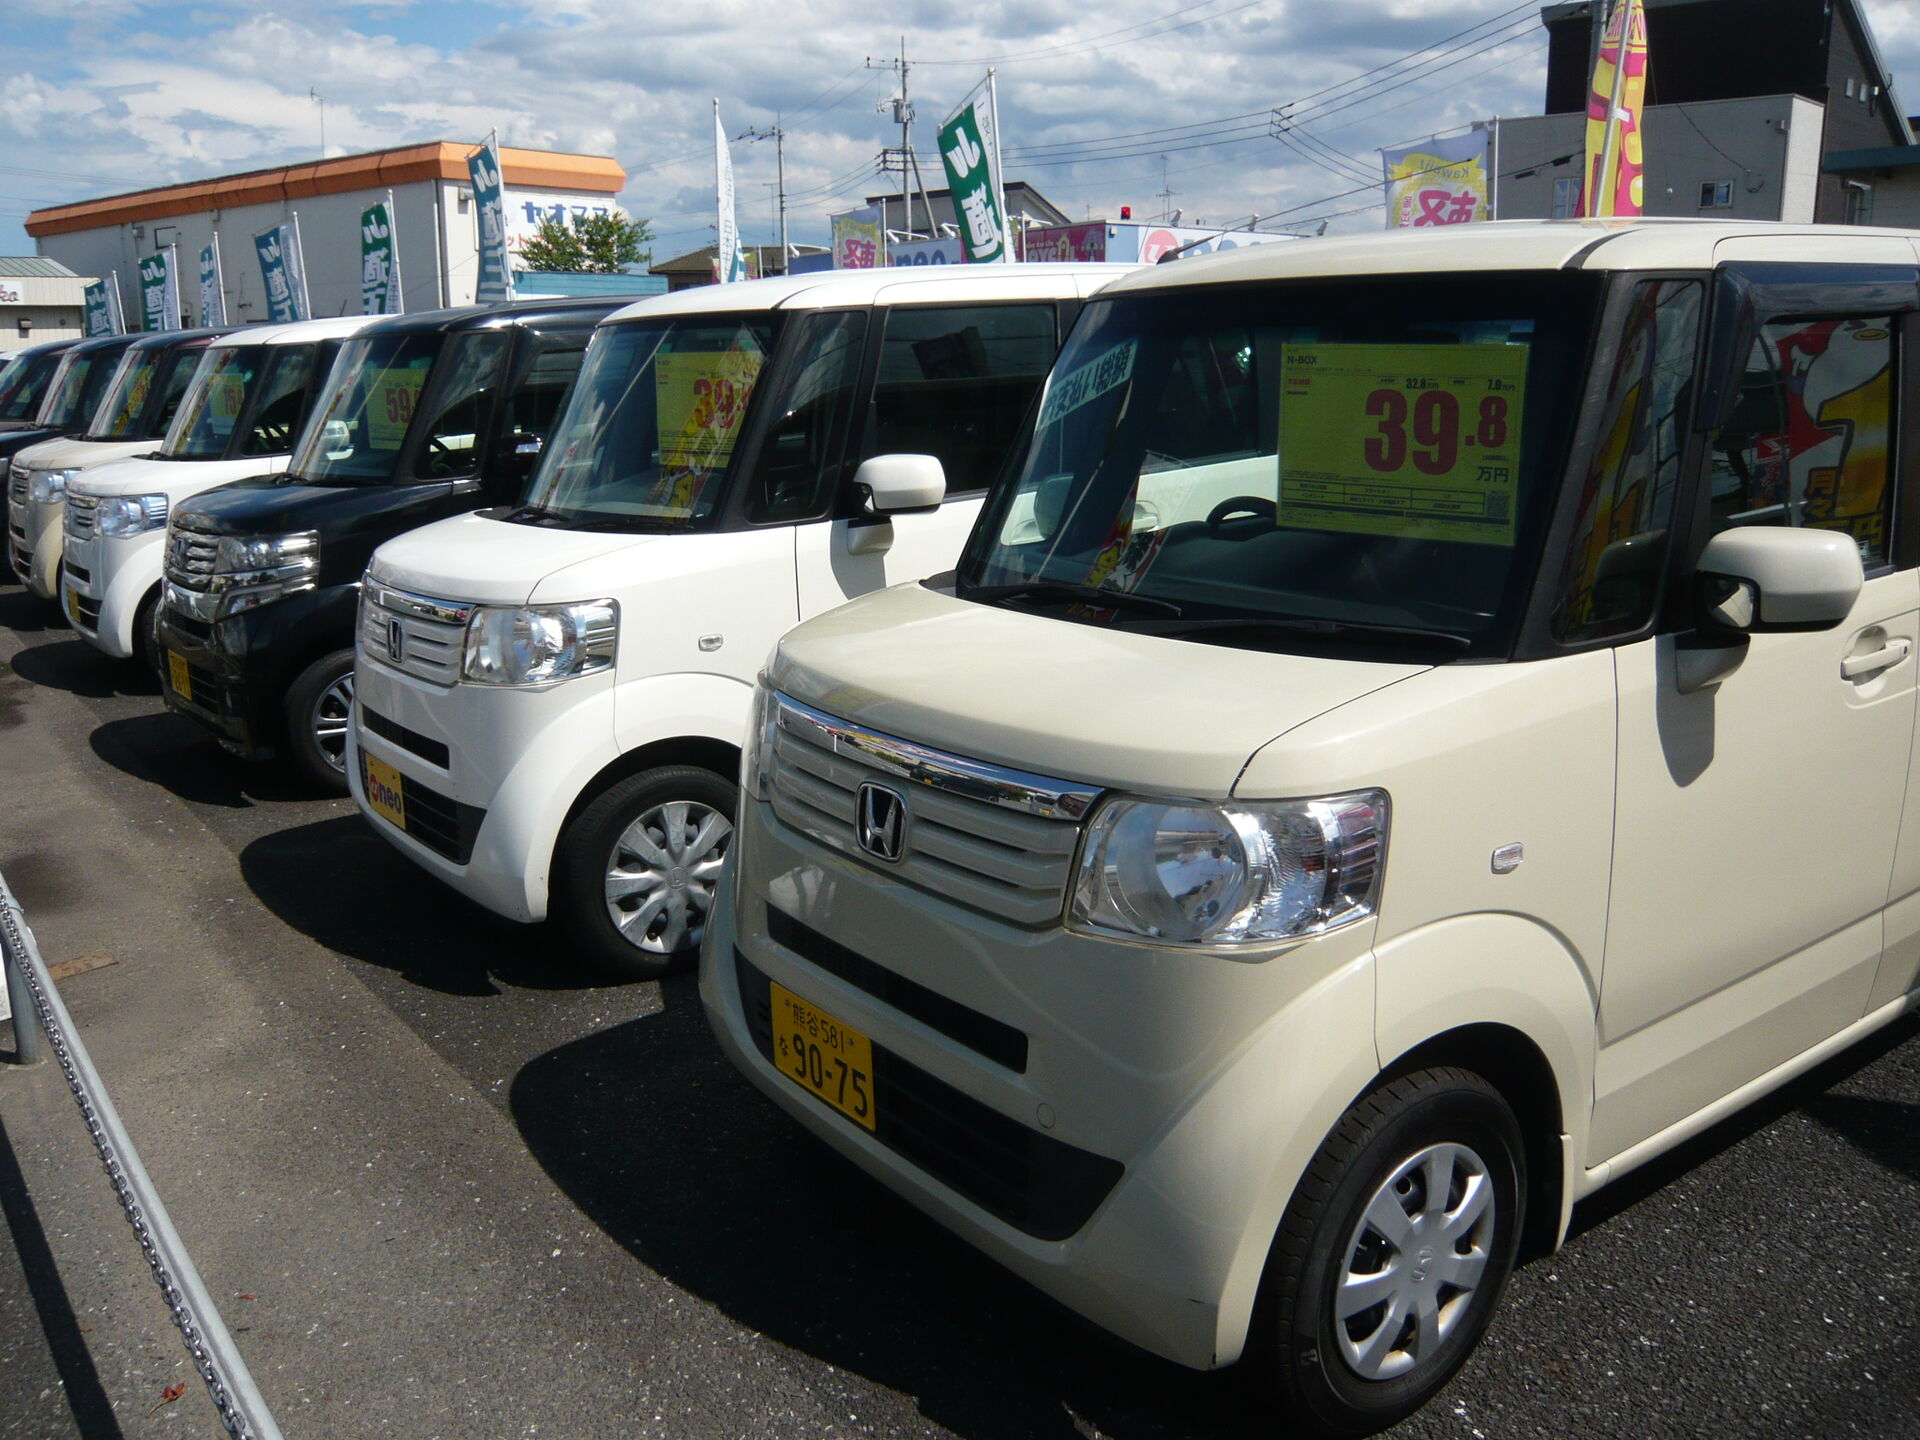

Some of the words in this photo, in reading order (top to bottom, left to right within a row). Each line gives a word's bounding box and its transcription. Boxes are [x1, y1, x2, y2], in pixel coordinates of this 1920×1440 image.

[1364, 389, 1508, 475] 39.8
[1475, 466, 1510, 483] 万円
[821, 1019, 844, 1053] 581
[793, 1033, 869, 1118] 90-75
